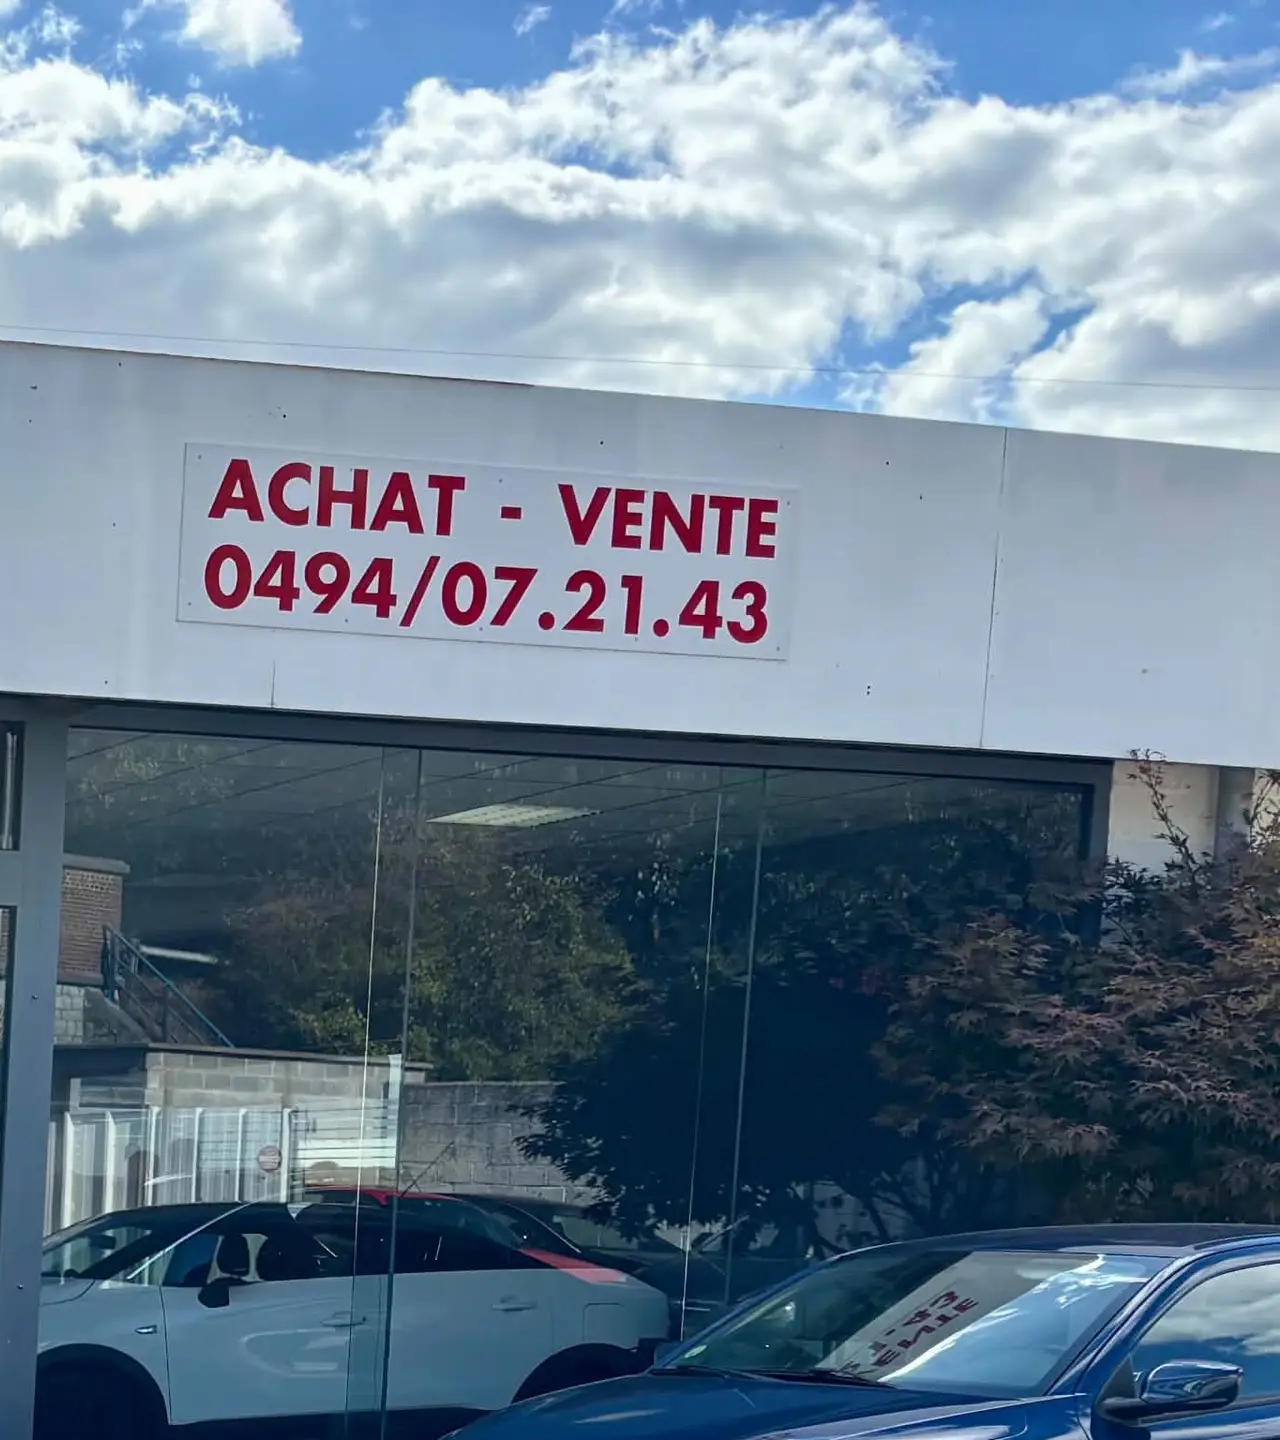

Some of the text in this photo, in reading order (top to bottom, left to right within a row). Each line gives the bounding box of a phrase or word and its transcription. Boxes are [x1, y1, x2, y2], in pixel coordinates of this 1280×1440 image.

[207, 458, 466, 537] ACHAT
[557, 482, 780, 560] VENTE
[203, 543, 769, 645] 0494/07.21.43
